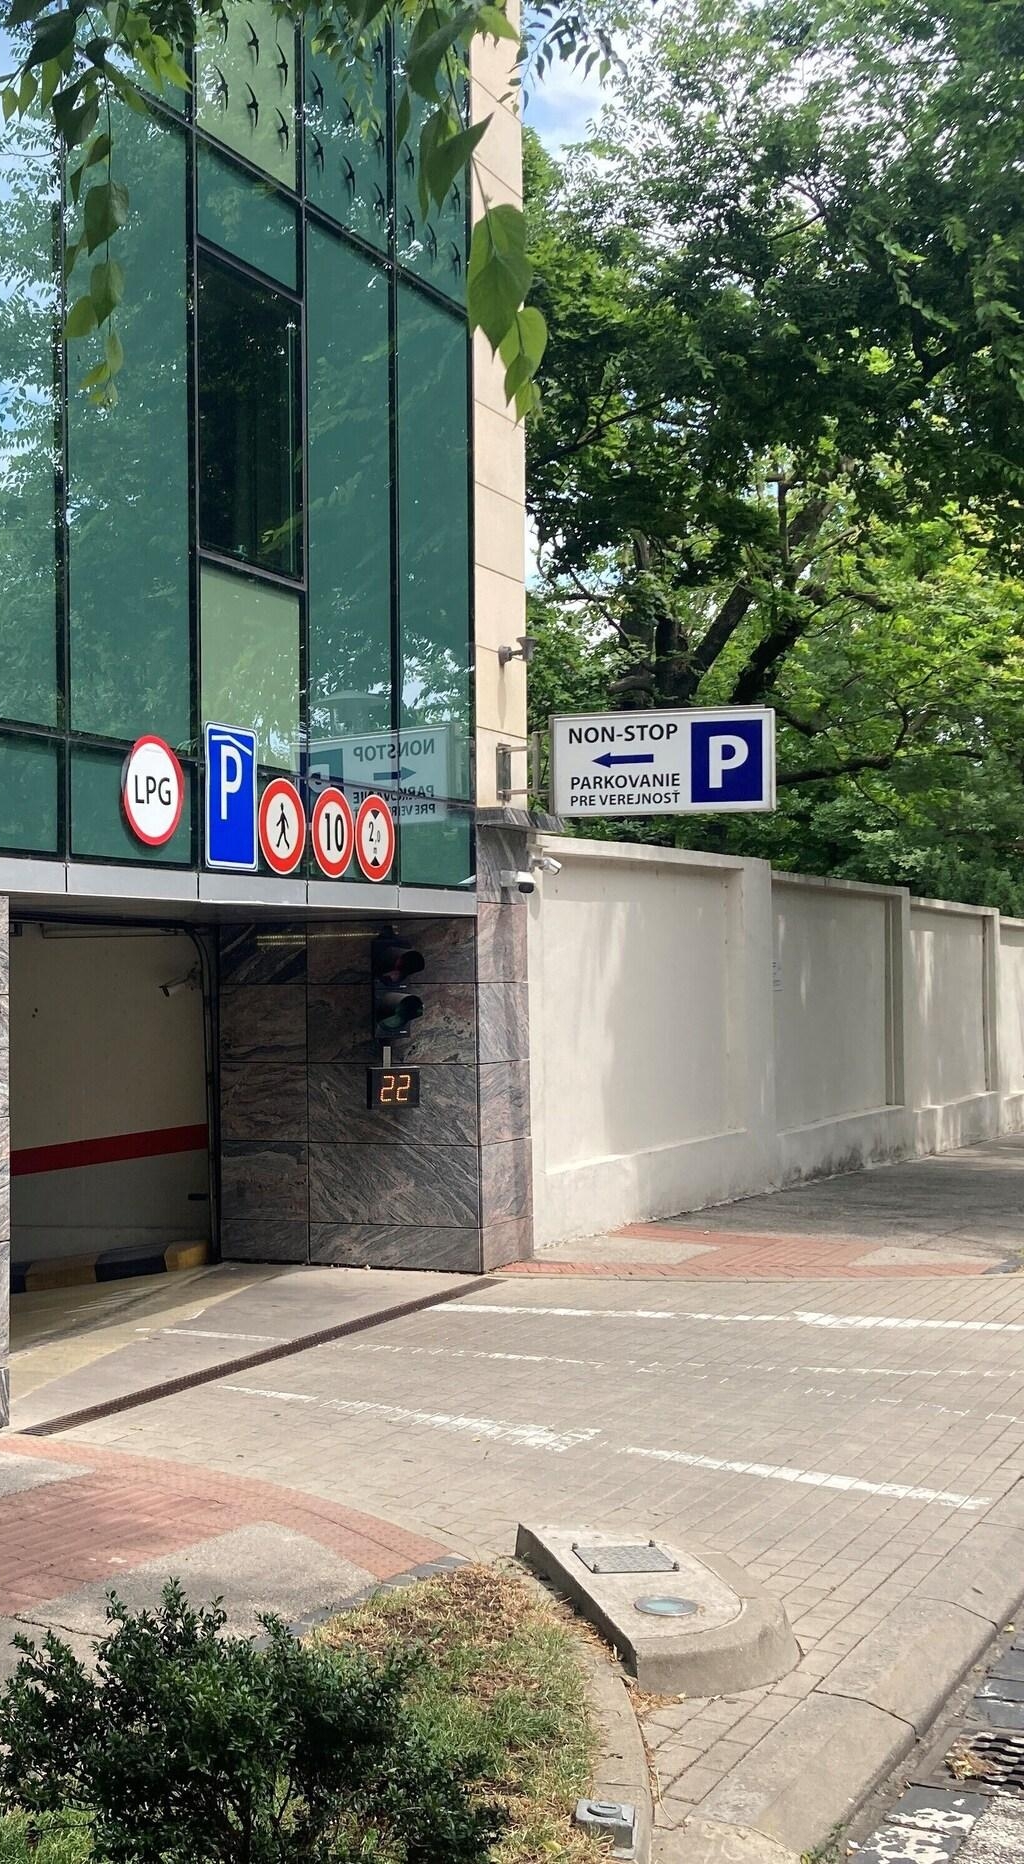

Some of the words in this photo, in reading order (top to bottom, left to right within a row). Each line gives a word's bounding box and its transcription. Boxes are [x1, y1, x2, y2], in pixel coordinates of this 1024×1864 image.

[568, 723, 678, 745] NON-STOP
[708, 734, 749, 789] P
[134, 774, 171, 806] LPG
[219, 744, 243, 820] P
[570, 773, 680, 790] PARKOVANIE
[570, 795, 596, 807] PRE
[599, 790, 680, 806] VEREJNOSŤ
[325, 813, 345, 852] 10
[380, 1074, 411, 1102] 22
